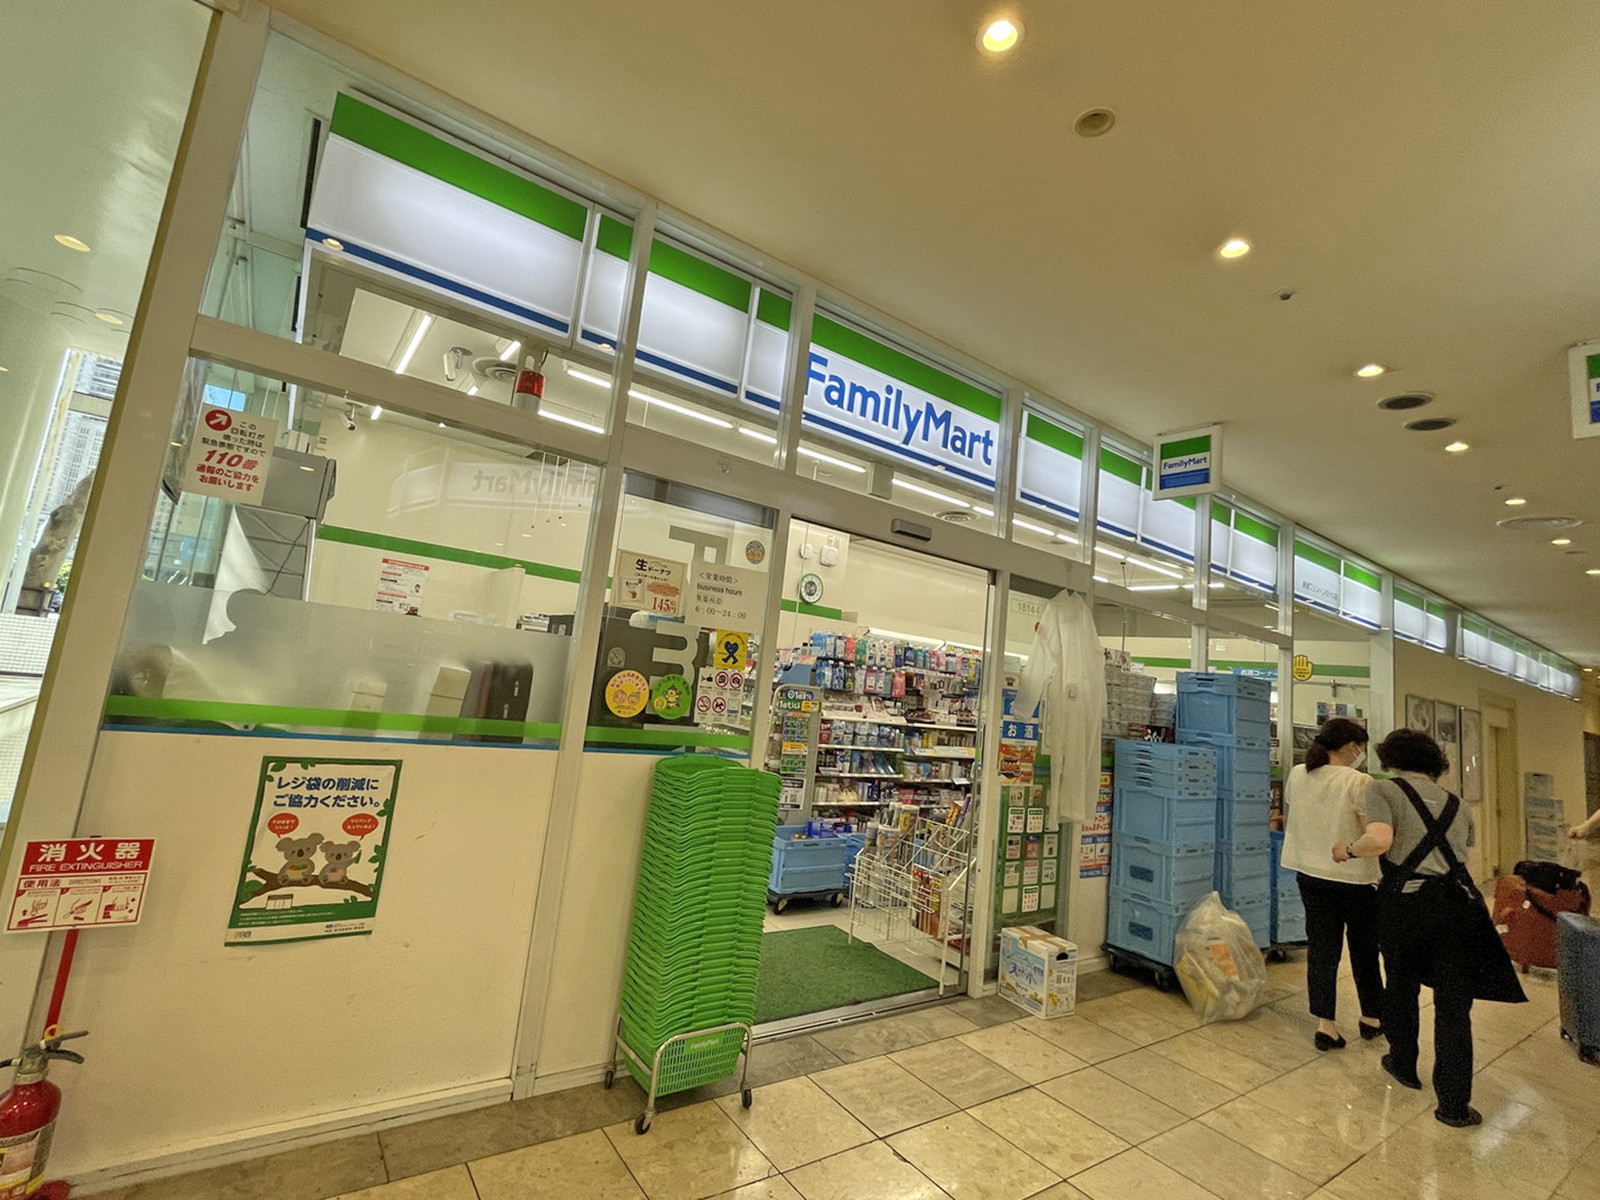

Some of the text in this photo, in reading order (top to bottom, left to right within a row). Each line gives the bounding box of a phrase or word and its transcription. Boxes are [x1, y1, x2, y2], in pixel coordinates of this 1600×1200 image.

[806, 352, 994, 466] FamilyMart
[240, 421, 257, 431] この
[204, 449, 259, 471] 110番
[1163, 456, 1207, 470] FamilyMart
[199, 475, 254, 492] お願いします
[635, 558, 672, 576] 生ドーナツ
[696, 582, 743, 597] business hours
[1007, 723, 1034, 739] お酒
[276, 776, 380, 792] レジ袋の削減に
[272, 793, 381, 809] ご協力ください。
[37, 842, 141, 863] 消火器
[29, 860, 143, 873] FIRE EXTINGUISHER
